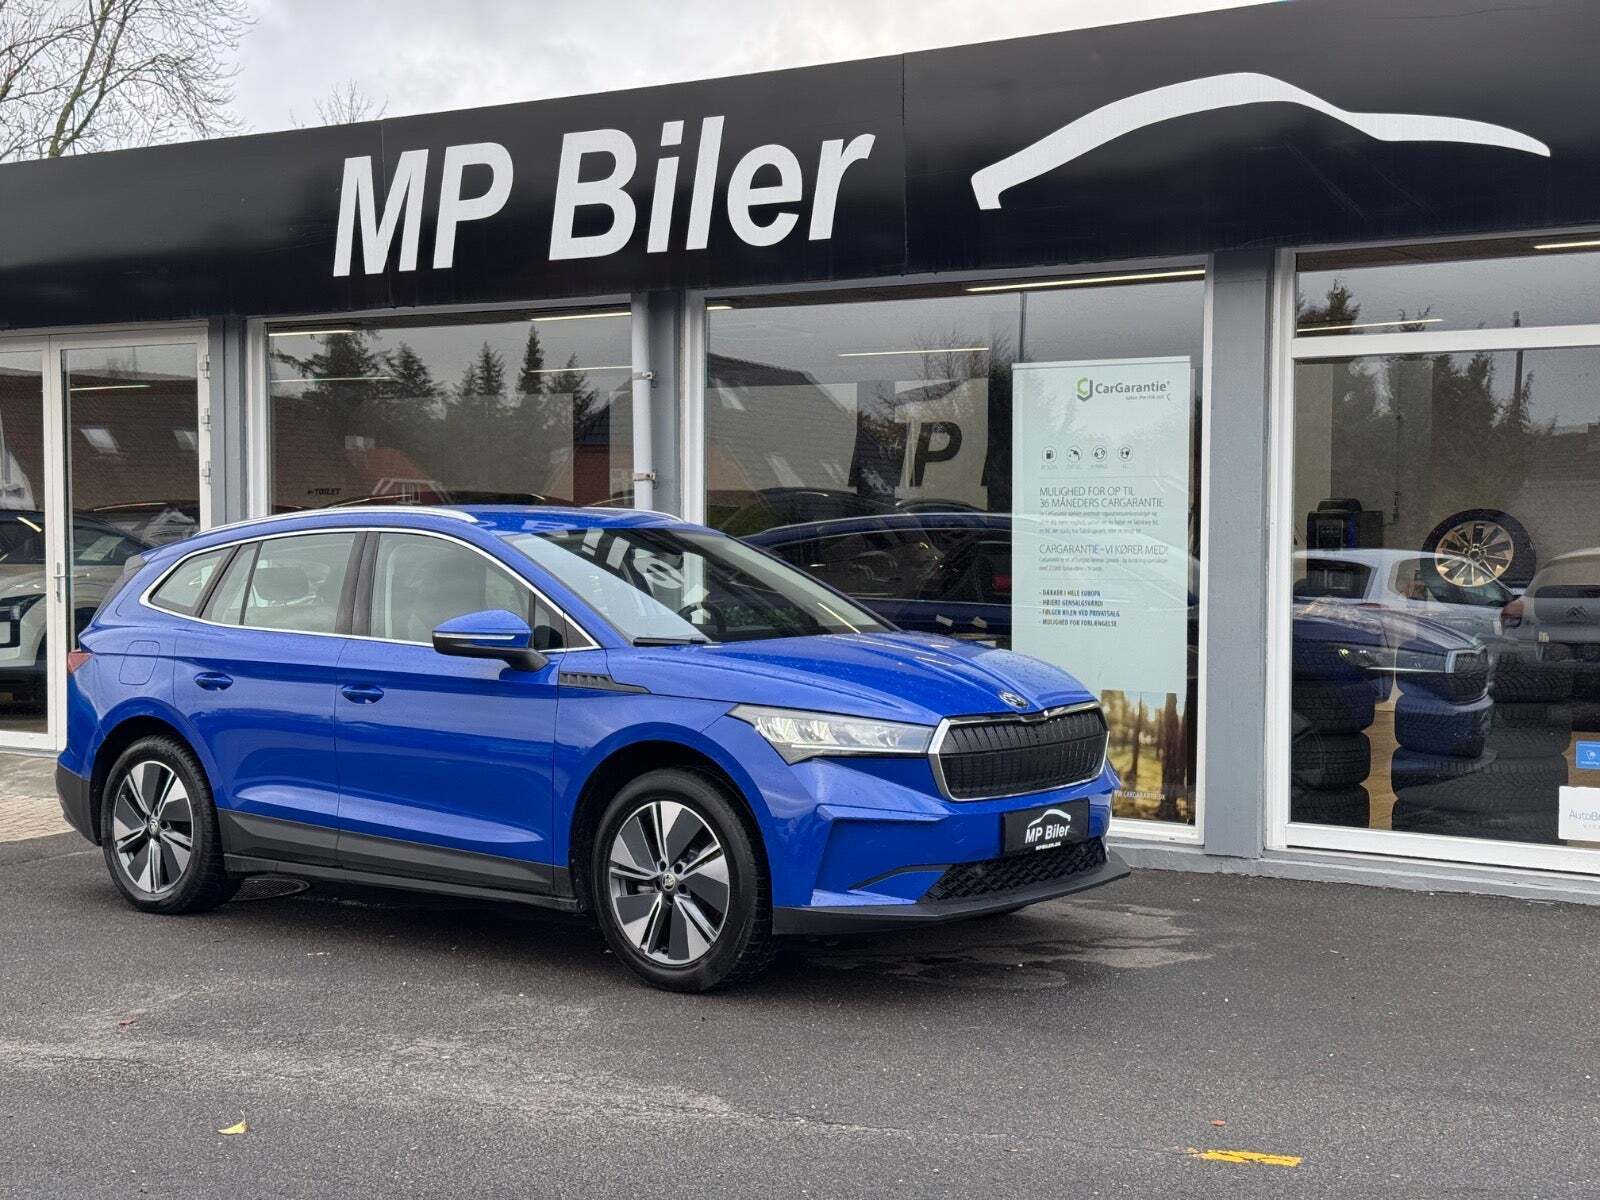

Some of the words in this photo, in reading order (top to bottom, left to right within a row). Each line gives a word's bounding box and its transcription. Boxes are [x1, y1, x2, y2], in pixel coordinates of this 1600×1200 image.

[333, 142, 514, 277] MP
[548, 115, 876, 261] Biler
[1095, 380, 1168, 394] CarGarantie
[1039, 487, 1086, 497] MULIGHED
[1088, 487, 1106, 496] FOR
[1107, 486, 1121, 496] OP
[1123, 486, 1136, 496] TIL
[1039, 498, 1050, 508] 36
[1051, 496, 1100, 508] MÅNEDERS
[1101, 497, 1165, 508] CARGARANTIE
[1025, 827, 1043, 844] MP
[1045, 823, 1070, 840] Biler
